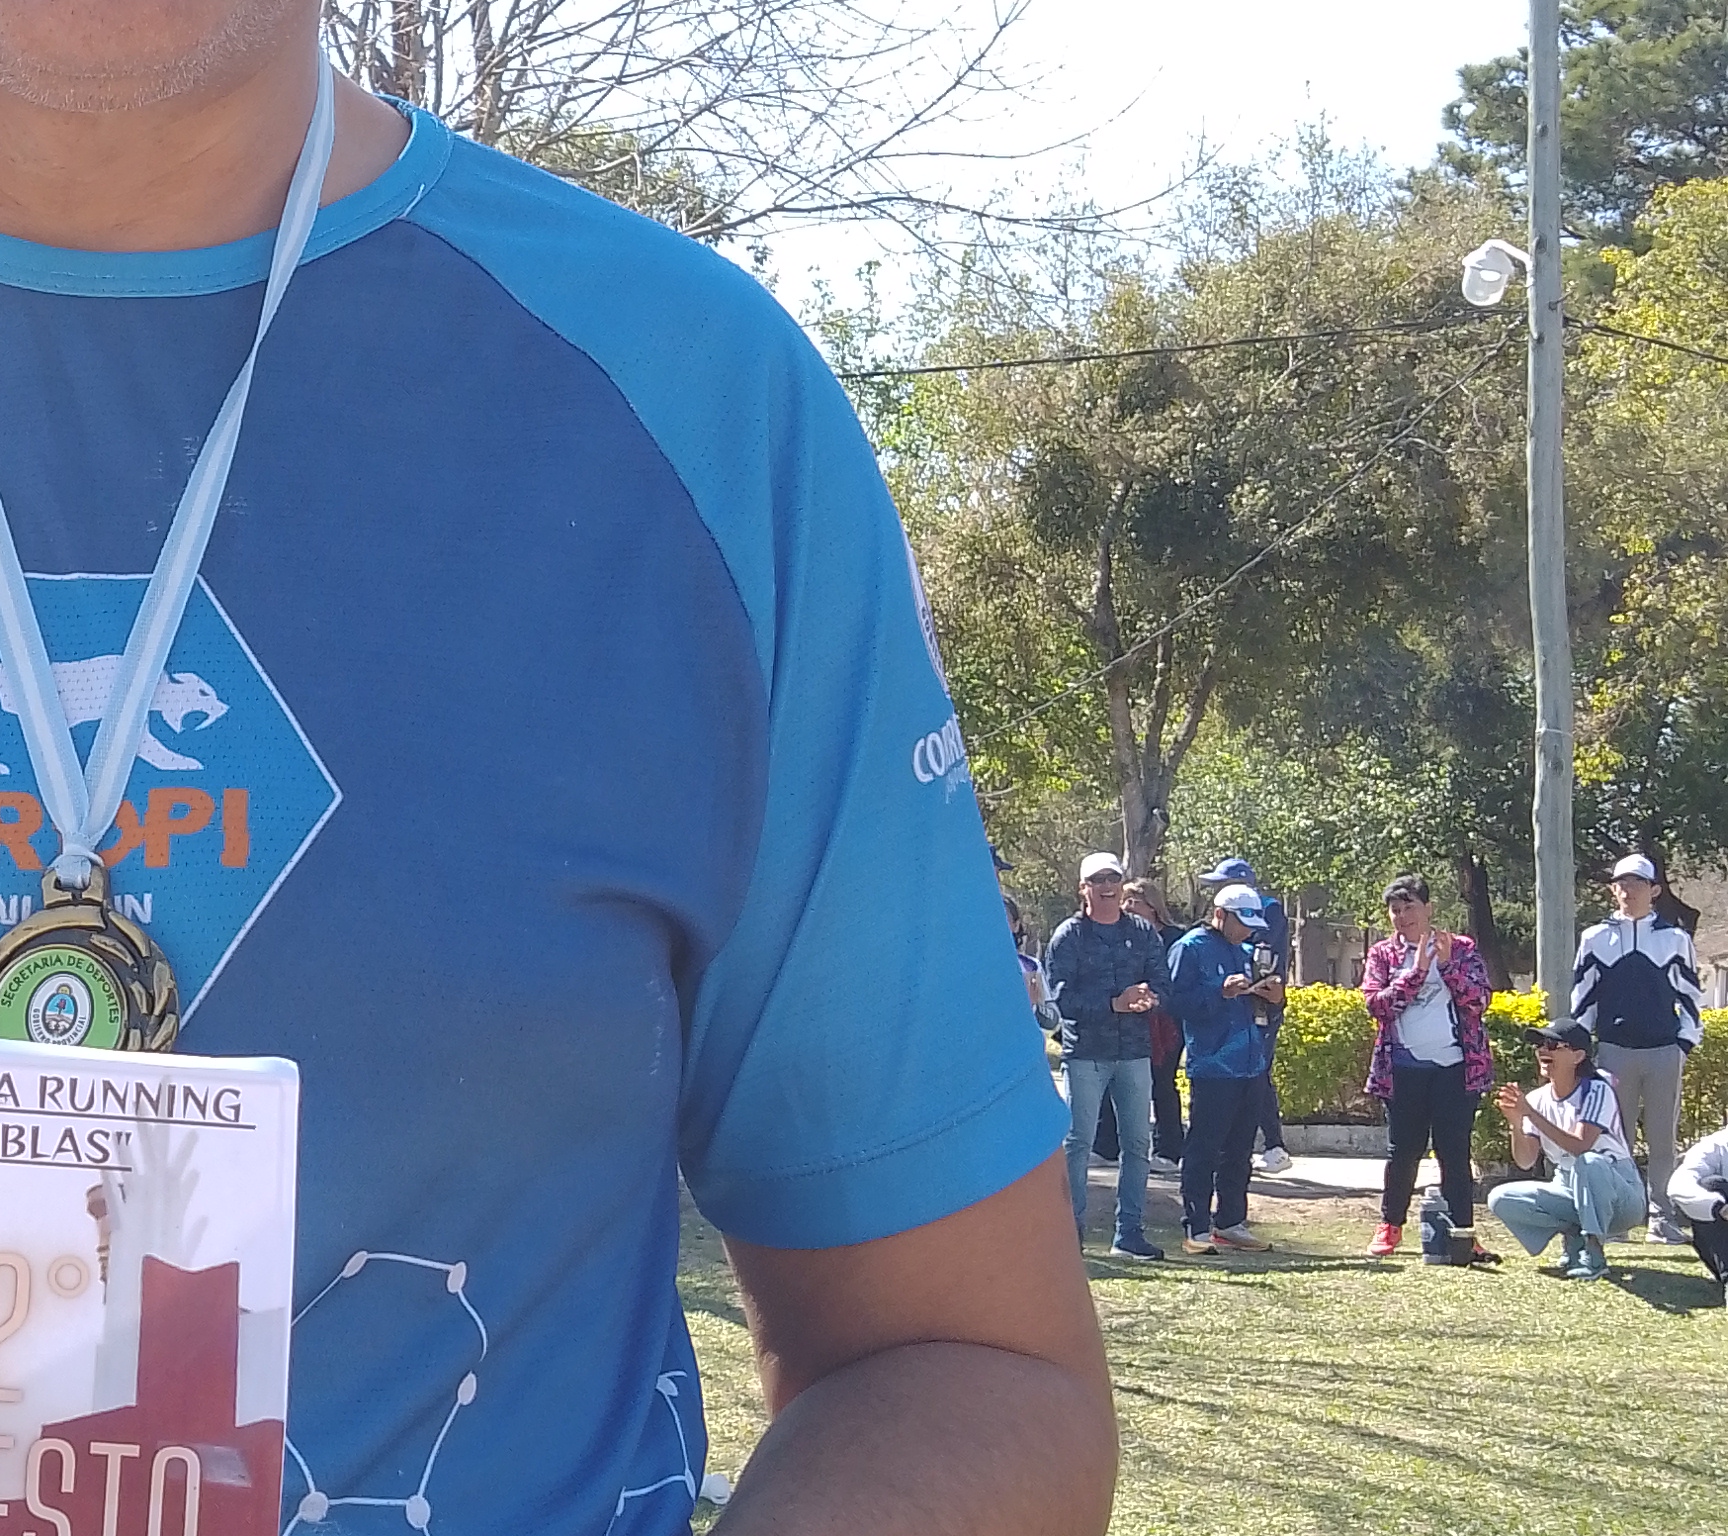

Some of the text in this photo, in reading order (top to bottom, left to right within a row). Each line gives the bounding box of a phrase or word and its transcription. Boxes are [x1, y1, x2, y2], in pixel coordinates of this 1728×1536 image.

[0, 953, 121, 1024] SECRETARIA DE DEPORTES
[38, 1075, 243, 1124] RUNNING
[1, 1122, 133, 1166] BLAS"
